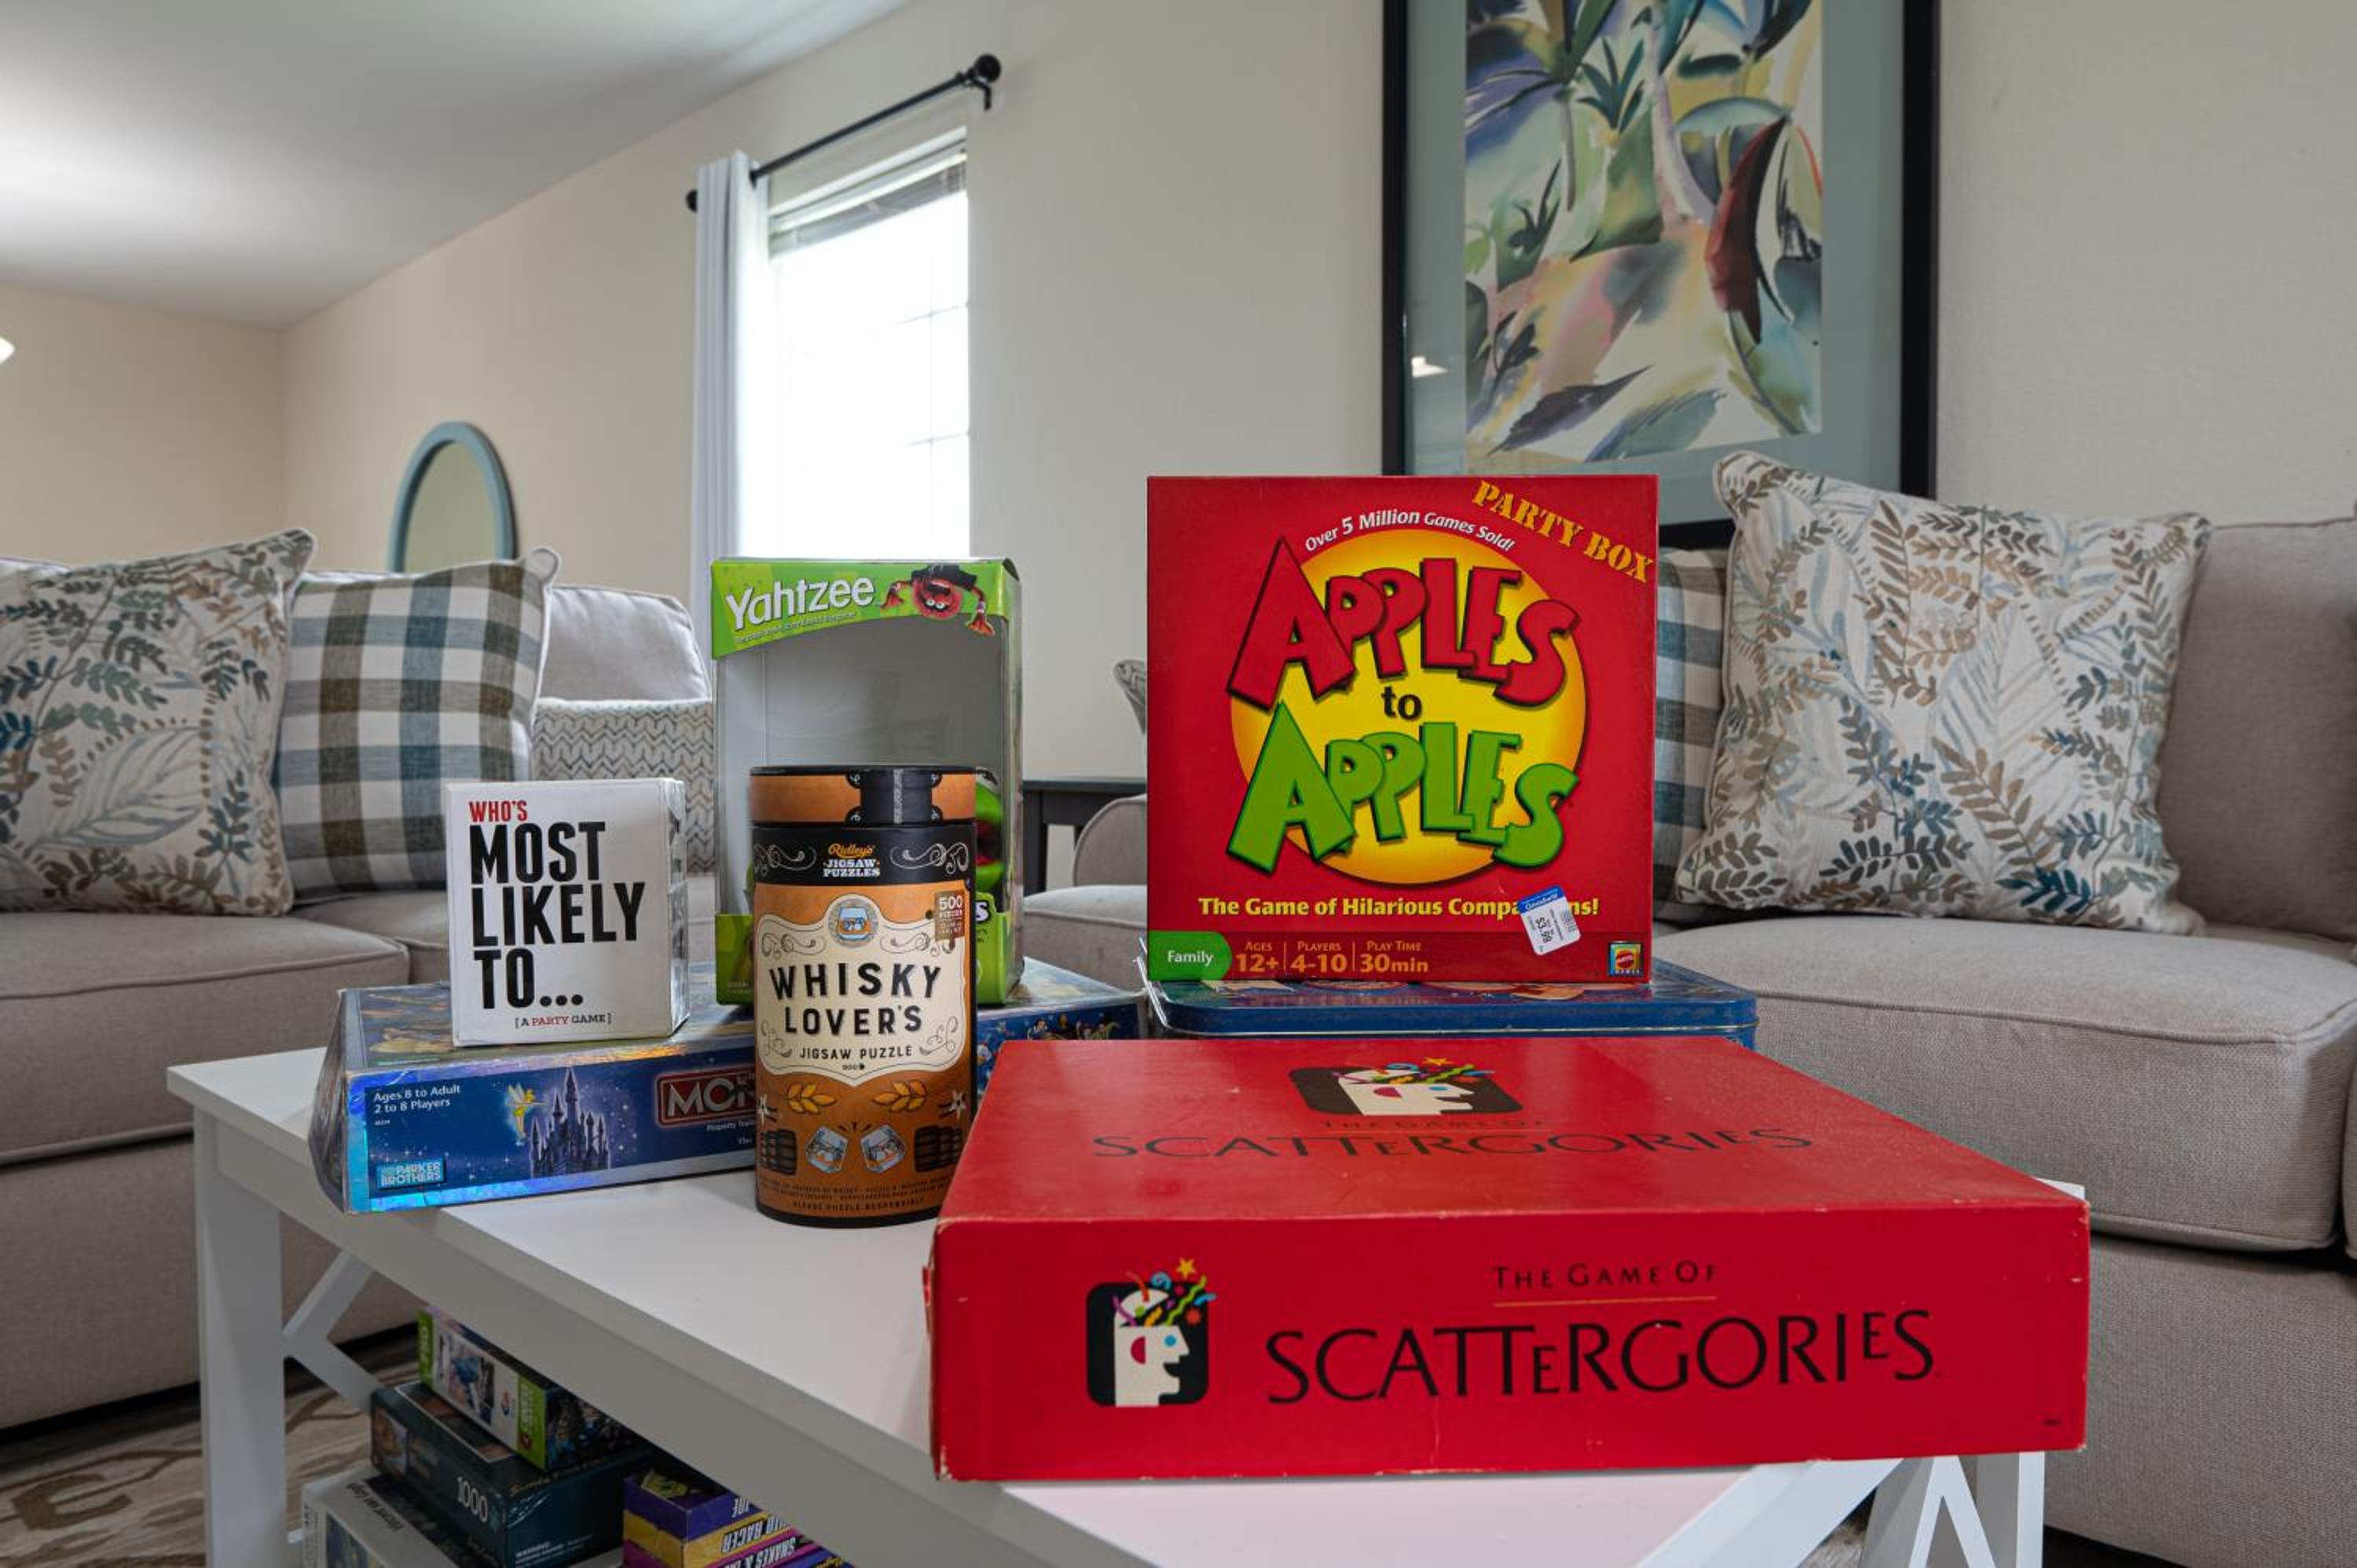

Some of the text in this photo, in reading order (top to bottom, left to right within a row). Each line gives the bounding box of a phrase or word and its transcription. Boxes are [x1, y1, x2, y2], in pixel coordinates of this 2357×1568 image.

[1305, 509, 1516, 551] Over 5 Million Games Sold!
[1472, 480, 1653, 583] PARTY BOX
[726, 578, 874, 631] Yahtzee
[1226, 537, 1581, 713] APPLES
[1381, 686, 1422, 720] to
[1226, 700, 1578, 874] APPLES
[469, 800, 528, 822] WHO'S
[469, 821, 606, 885] MOST
[826, 859, 877, 868] JIGSAW
[823, 867, 880, 877] PUZZLES
[471, 881, 645, 947] LIKELY
[939, 895, 962, 910] 500
[1199, 898, 1239, 914] The
[1245, 898, 1311, 915] Game
[1314, 897, 1337, 914] of
[1343, 897, 1443, 915] Hilarious
[1168, 951, 1214, 967] Family
[1236, 954, 1279, 973] 12+
[1290, 954, 1347, 973] 4-10
[1360, 954, 1428, 973] 30min
[473, 947, 583, 1009] TO...
[769, 962, 941, 1002] WHISKY
[532, 1015, 570, 1026] PARTY
[784, 1005, 922, 1035] LOVER'S
[800, 1046, 911, 1060] JIGSAW PUZZLE
[374, 1093, 402, 1103] Ages
[405, 1090, 412, 1098] 8
[431, 1085, 461, 1096] Adult
[374, 1105, 381, 1113] 2
[401, 1102, 407, 1111] 8
[411, 1099, 450, 1111] Players
[1094, 1129, 1813, 1157] SCATTERGORIES
[381, 1172, 440, 1186] BROTHERS
[396, 1163, 440, 1174] PARKER
[1494, 1260, 1717, 1291] THE GAME OF
[1265, 1309, 1935, 1405] SCATTERGORIES
[456, 1476, 488, 1522] 1000
